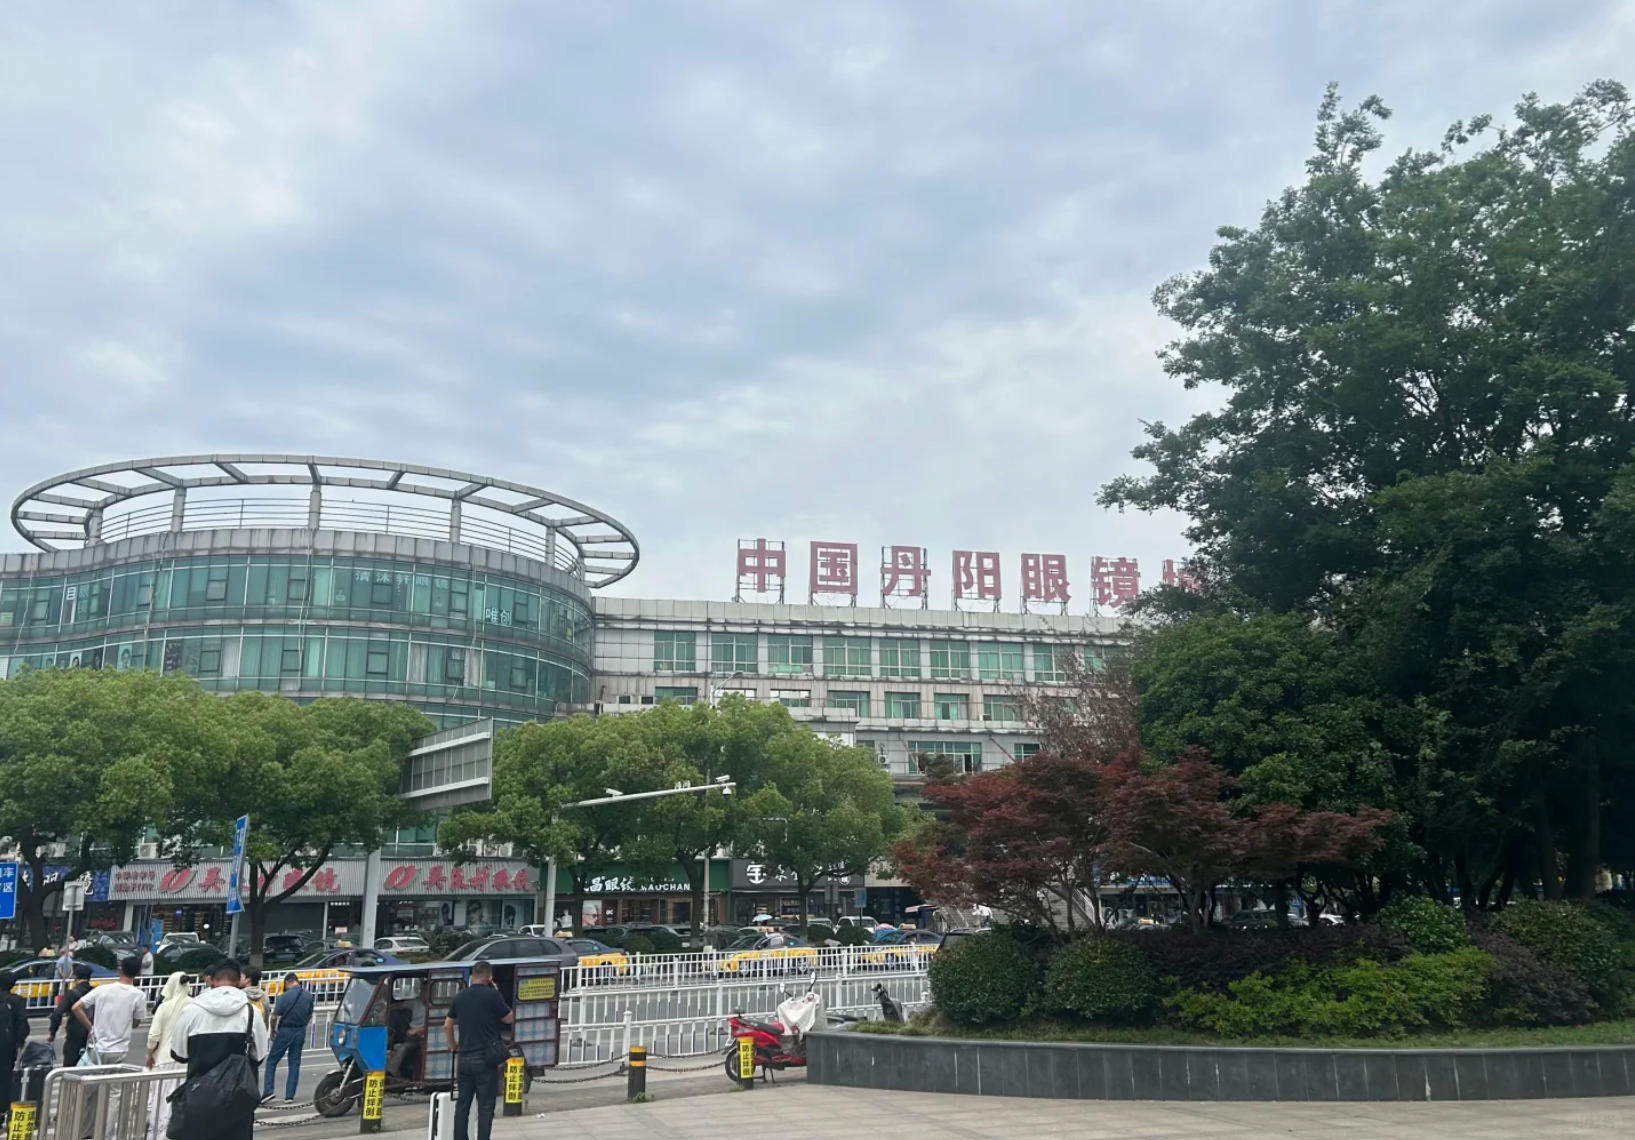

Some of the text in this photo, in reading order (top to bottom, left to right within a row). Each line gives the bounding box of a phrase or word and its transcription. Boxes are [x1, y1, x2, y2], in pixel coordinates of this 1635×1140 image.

[485, 607, 513, 625] 唯创
[0, 882, 14, 892] 区
[366, 1079, 378, 1116] 防止绊倒
